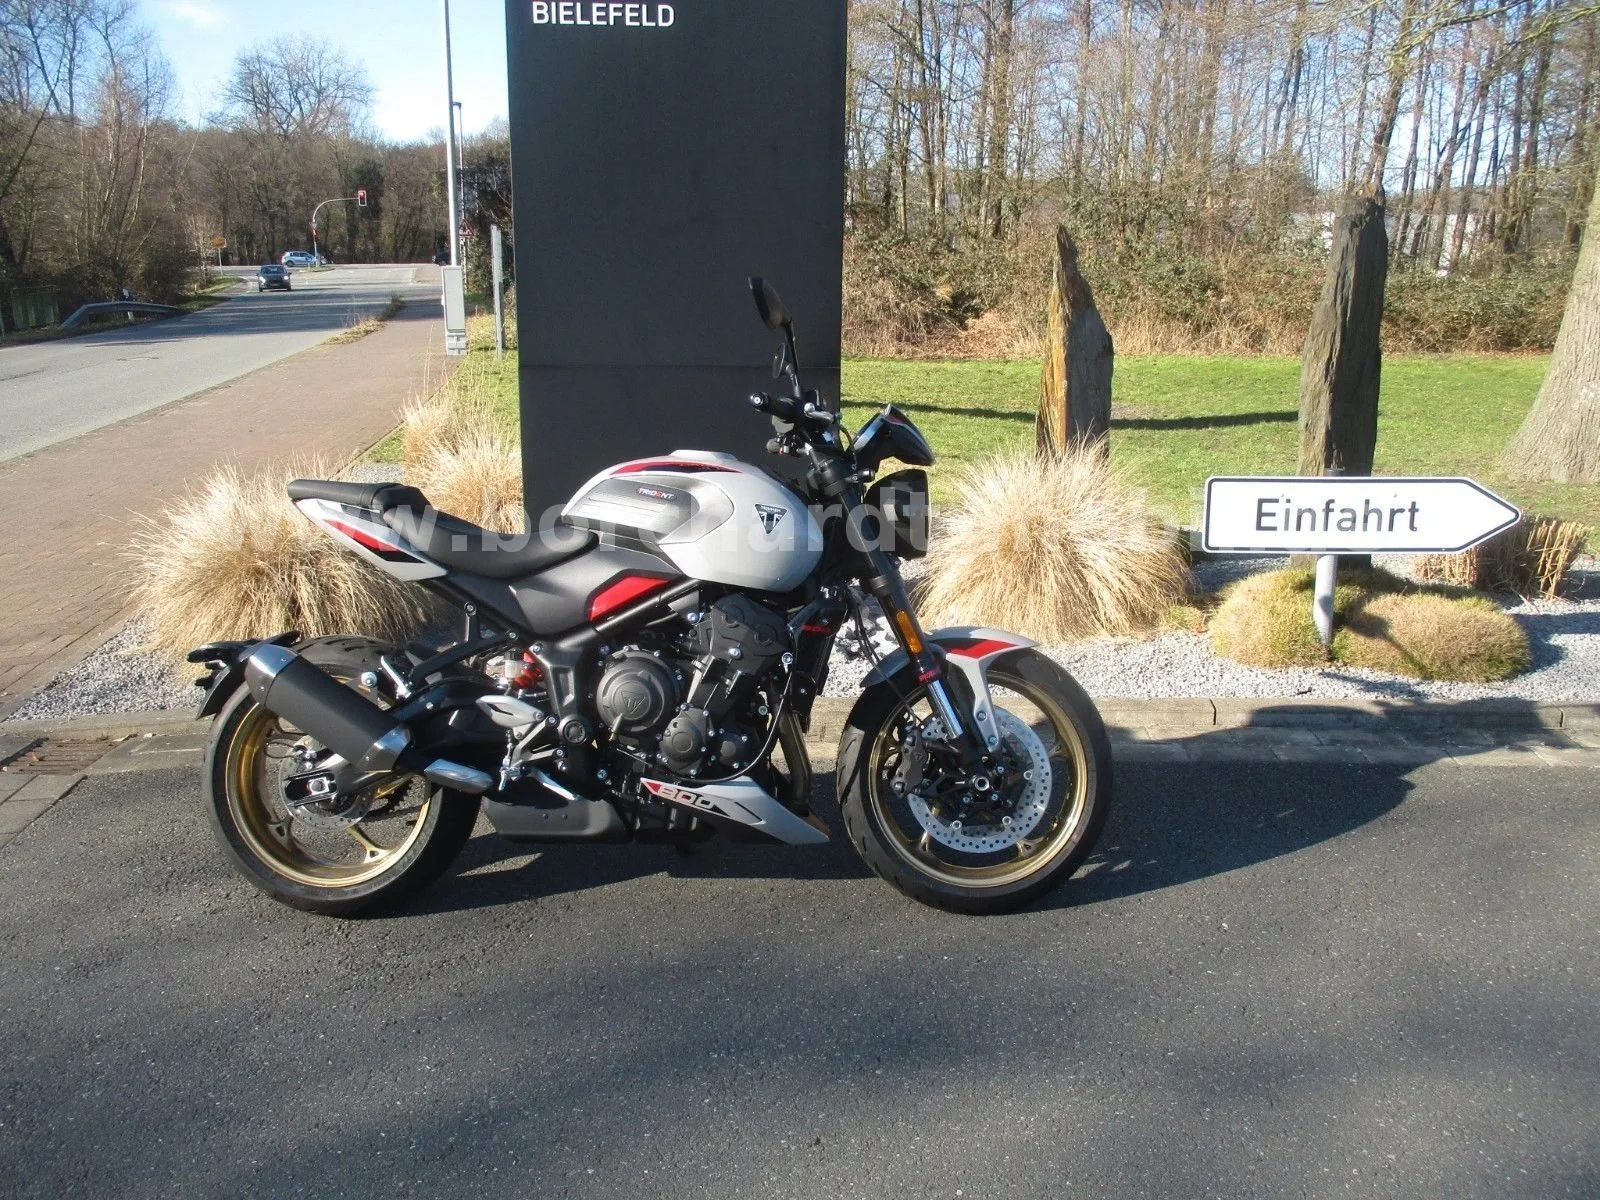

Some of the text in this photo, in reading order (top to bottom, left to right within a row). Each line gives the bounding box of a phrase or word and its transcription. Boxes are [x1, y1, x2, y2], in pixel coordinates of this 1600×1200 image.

[532, 1, 675, 27] BIELEFELD
[637, 487, 675, 500] TRIDENT
[1255, 498, 1419, 532] Einfahrt
[658, 784, 715, 809] 800
